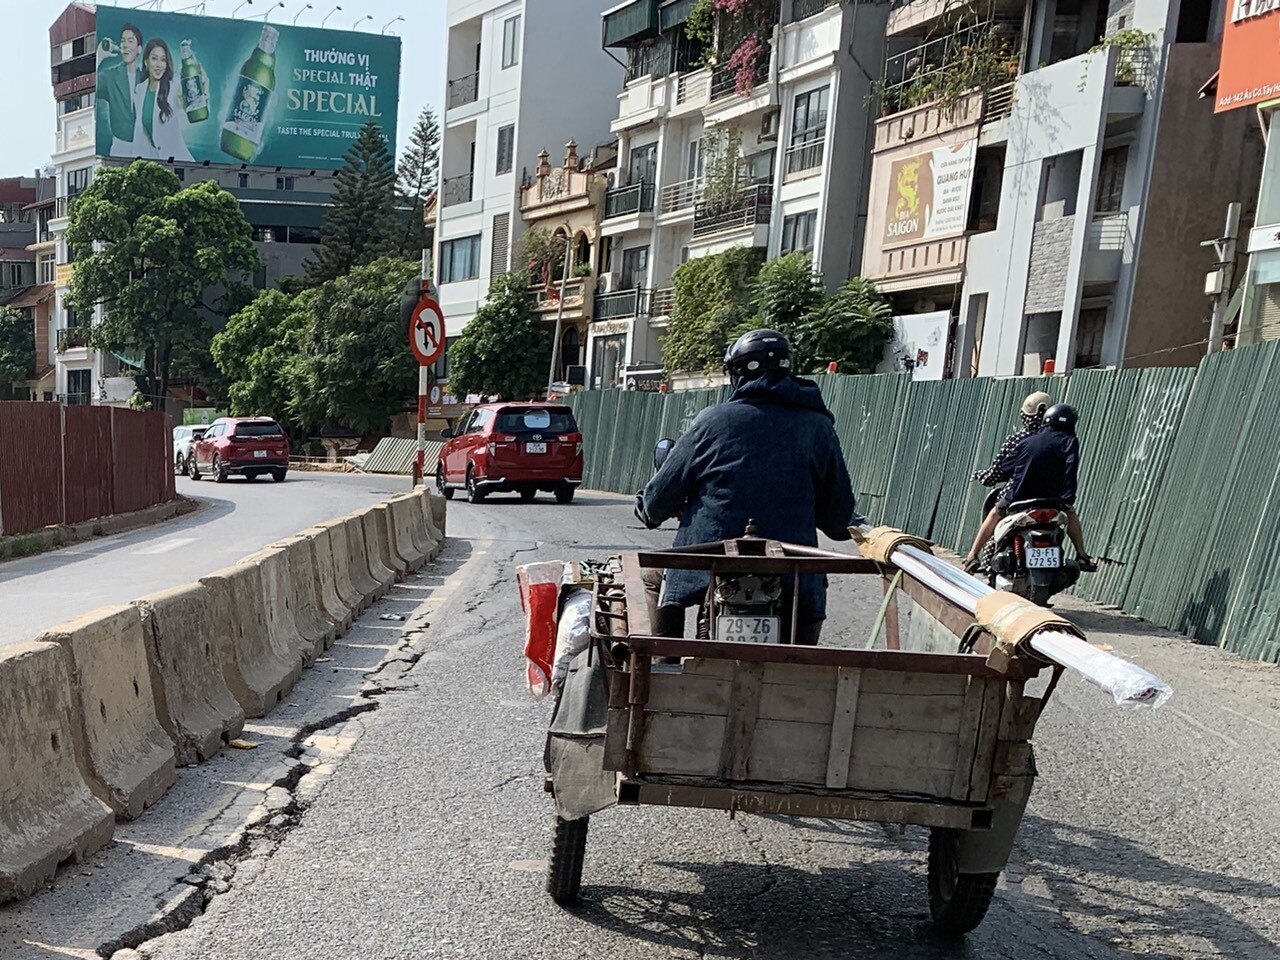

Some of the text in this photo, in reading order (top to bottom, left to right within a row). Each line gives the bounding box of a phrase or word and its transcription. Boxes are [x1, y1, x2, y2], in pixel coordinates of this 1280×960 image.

[304, 48, 370, 71] THƯỞNG VỊ
[293, 68, 378, 91] SPECIAL THẬT
[286, 88, 383, 117] SPECIAL
[277, 126, 298, 135] TASTE
[299, 127, 312, 136] THE
[313, 128, 340, 138] SPECIAL
[936, 171, 959, 185] QUANG
[899, 211, 910, 220] BIA
[887, 218, 920, 237] SAIGON
[1031, 548, 1054, 557] 29-F1
[726, 618, 771, 635] 29-Z6
